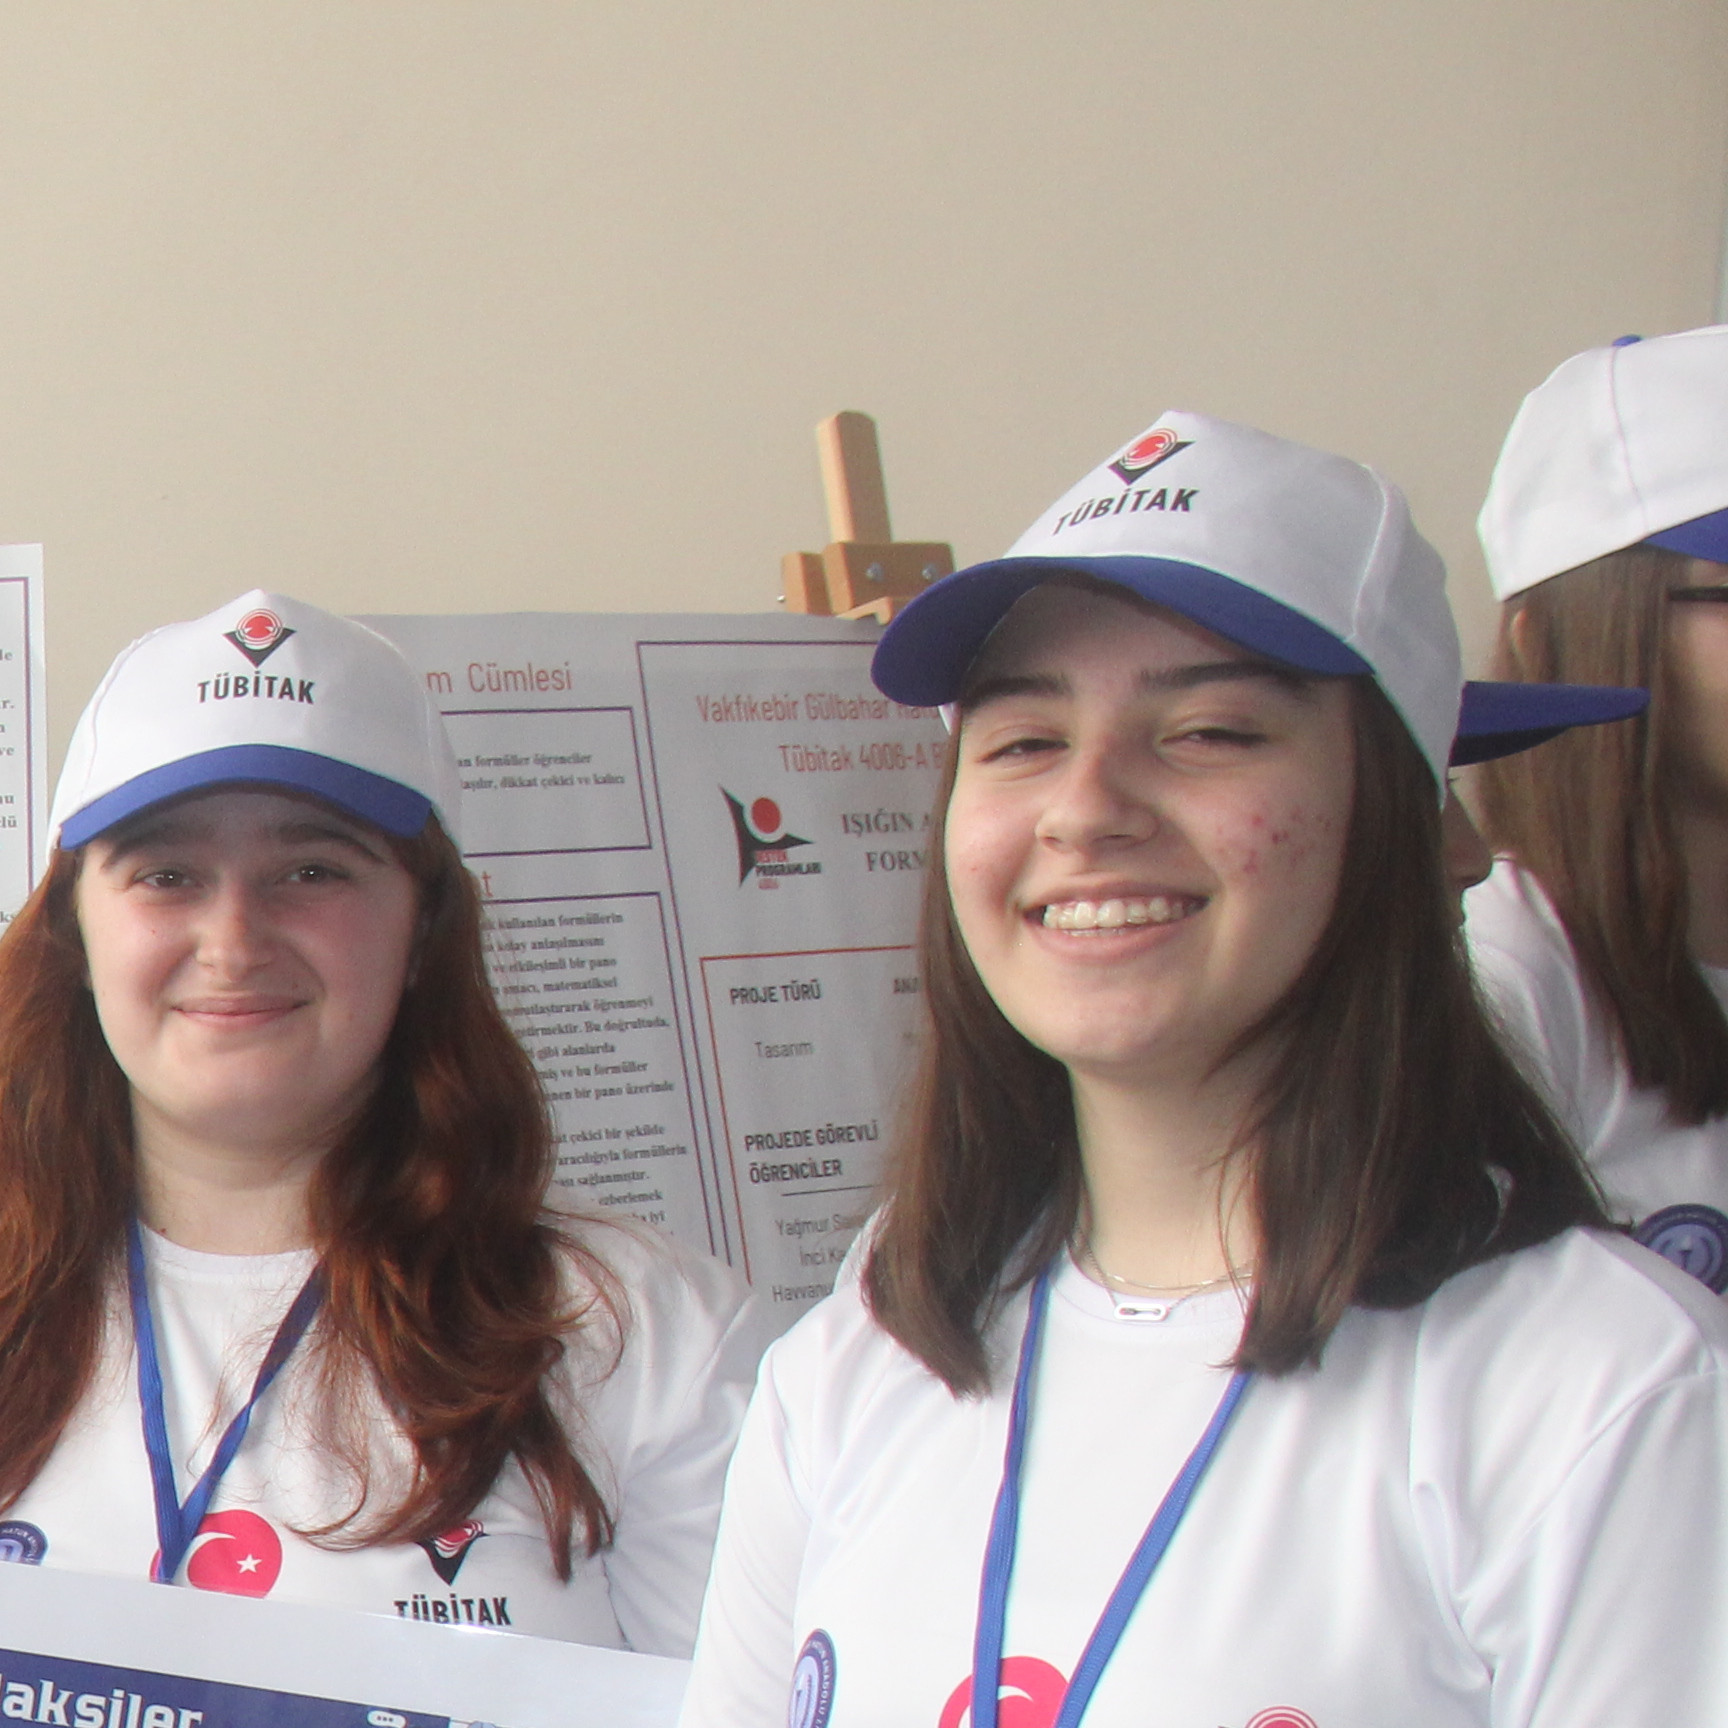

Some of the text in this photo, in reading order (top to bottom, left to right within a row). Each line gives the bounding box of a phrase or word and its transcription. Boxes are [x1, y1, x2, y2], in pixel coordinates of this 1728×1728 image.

[1054, 489, 1198, 534] TÜBİTAK
[198, 671, 314, 704] TÜBİTAK
[467, 662, 572, 694] Cümlesi
[779, 743, 928, 771] Tübitak 4006-A
[730, 978, 821, 1004] PROJE TÜRÜ
[755, 1040, 813, 1059] Tasarım
[745, 1120, 878, 1152] PROJEDE GÖREVLİ
[749, 1158, 843, 1185] ÖĞRENCİLER
[394, 1593, 511, 1625] TÜBİTAK
